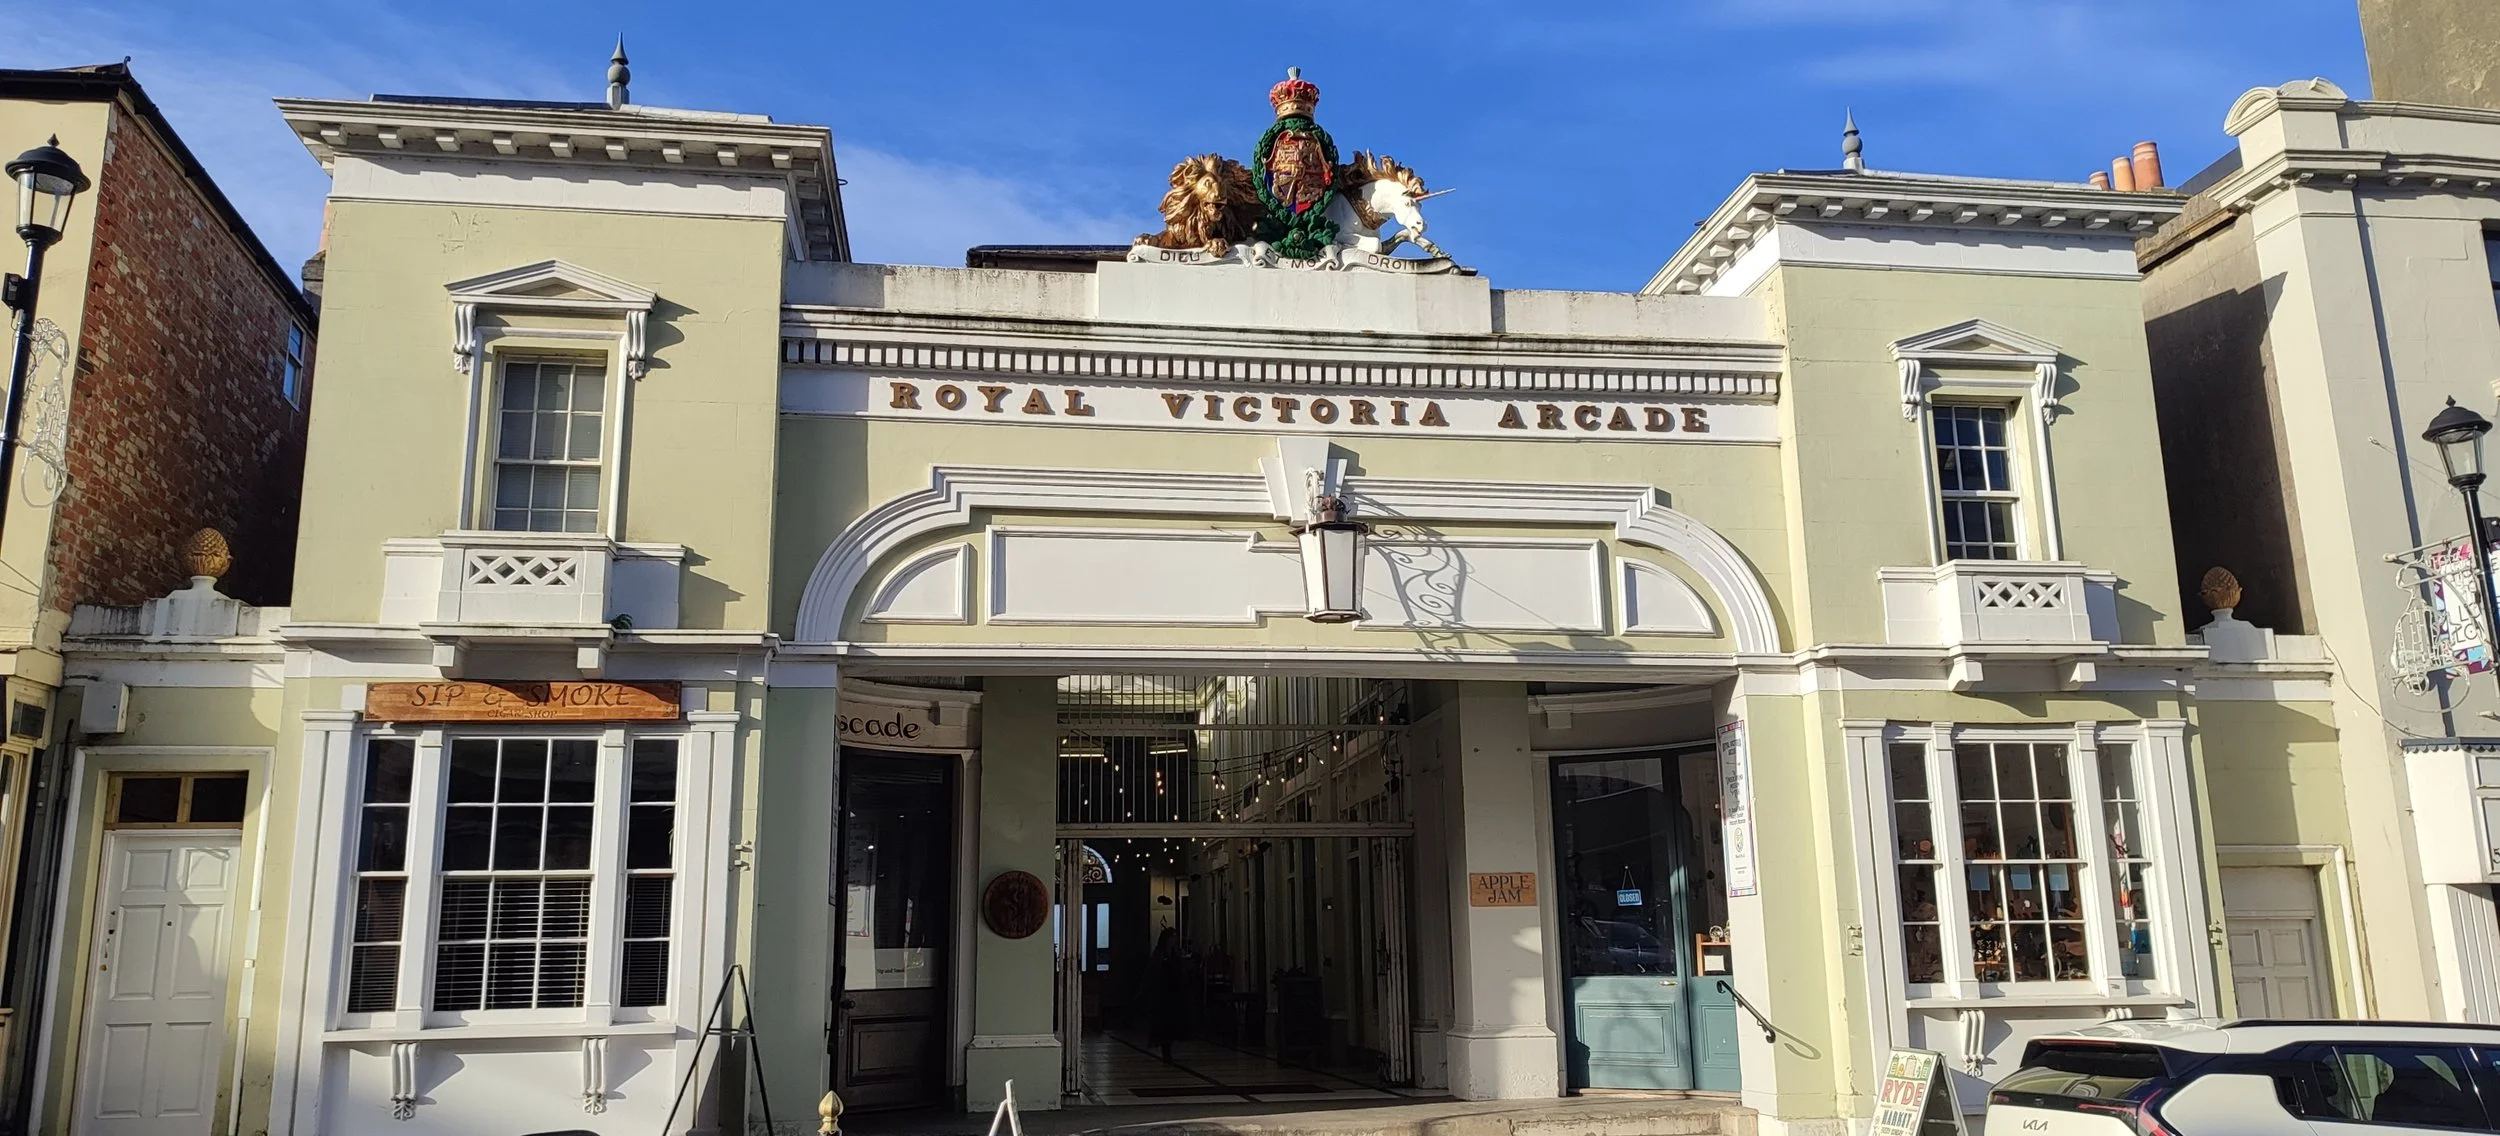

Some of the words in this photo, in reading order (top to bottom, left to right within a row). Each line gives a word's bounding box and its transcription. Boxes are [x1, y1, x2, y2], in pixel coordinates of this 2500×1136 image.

[1159, 250, 1201, 263] DIEU
[1368, 253, 1417, 271] DROIT
[888, 381, 1094, 417] ROYAL
[1160, 392, 1448, 427] VICTORIA
[1496, 403, 1710, 433] ARCADE
[411, 683, 465, 707] SIP
[483, 684, 507, 708] &
[526, 683, 631, 707] SMOKE
[487, 709, 522, 719] CIGAR
[527, 709, 558, 719] SHOP
[1478, 875, 1530, 889] APPLE
[1488, 889, 1521, 903] JAM
[1618, 893, 1640, 902] CLOSED
[1881, 1079, 1926, 1107] RYDE
[1881, 1109, 1912, 1129] MARKET
